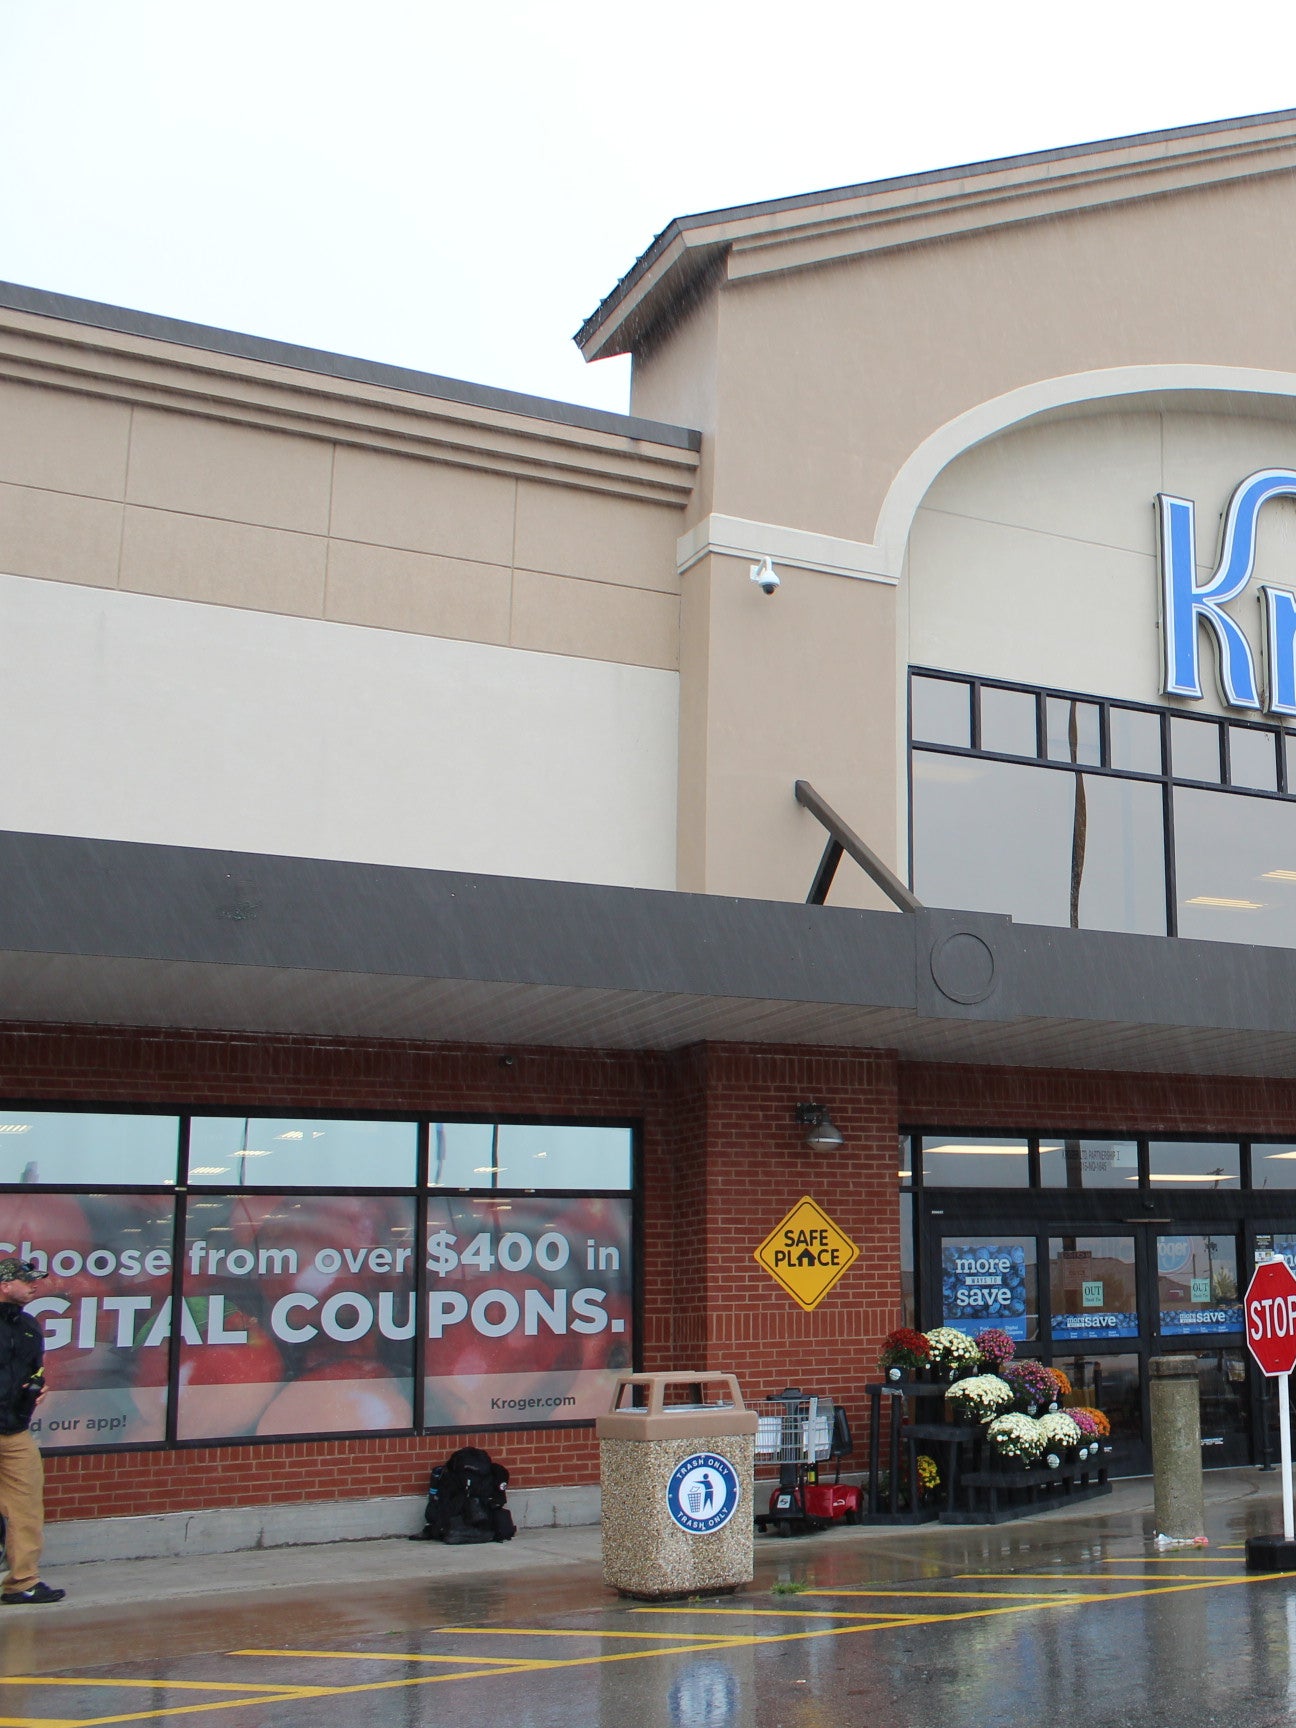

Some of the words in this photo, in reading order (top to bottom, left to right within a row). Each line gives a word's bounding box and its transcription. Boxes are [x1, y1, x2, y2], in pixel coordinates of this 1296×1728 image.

[783, 1229, 829, 1248] SAFE
[188, 1240, 298, 1276] from
[314, 1247, 412, 1274] over
[426, 1229, 570, 1278] $400
[586, 1238, 621, 1271] in
[955, 1258, 1011, 1273] more
[971, 1276, 987, 1284] WAYS
[990, 1276, 998, 1284] TO
[1192, 1282, 1209, 1292] OUT
[956, 1287, 1012, 1306] save
[1084, 1286, 1101, 1296] OUT
[22, 1295, 248, 1351] GITAL
[270, 1287, 625, 1344] COUPONS.
[1085, 1315, 1116, 1327] save
[1197, 1311, 1226, 1322] save
[490, 1394, 577, 1411] Kroger.com
[48, 1419, 81, 1432] our
[86, 1414, 127, 1432] app!
[676, 1458, 704, 1479] TRASH
[708, 1458, 729, 1476] ONLY
[676, 1511, 705, 1529] TRASH
[708, 1506, 729, 1527] ONLY
